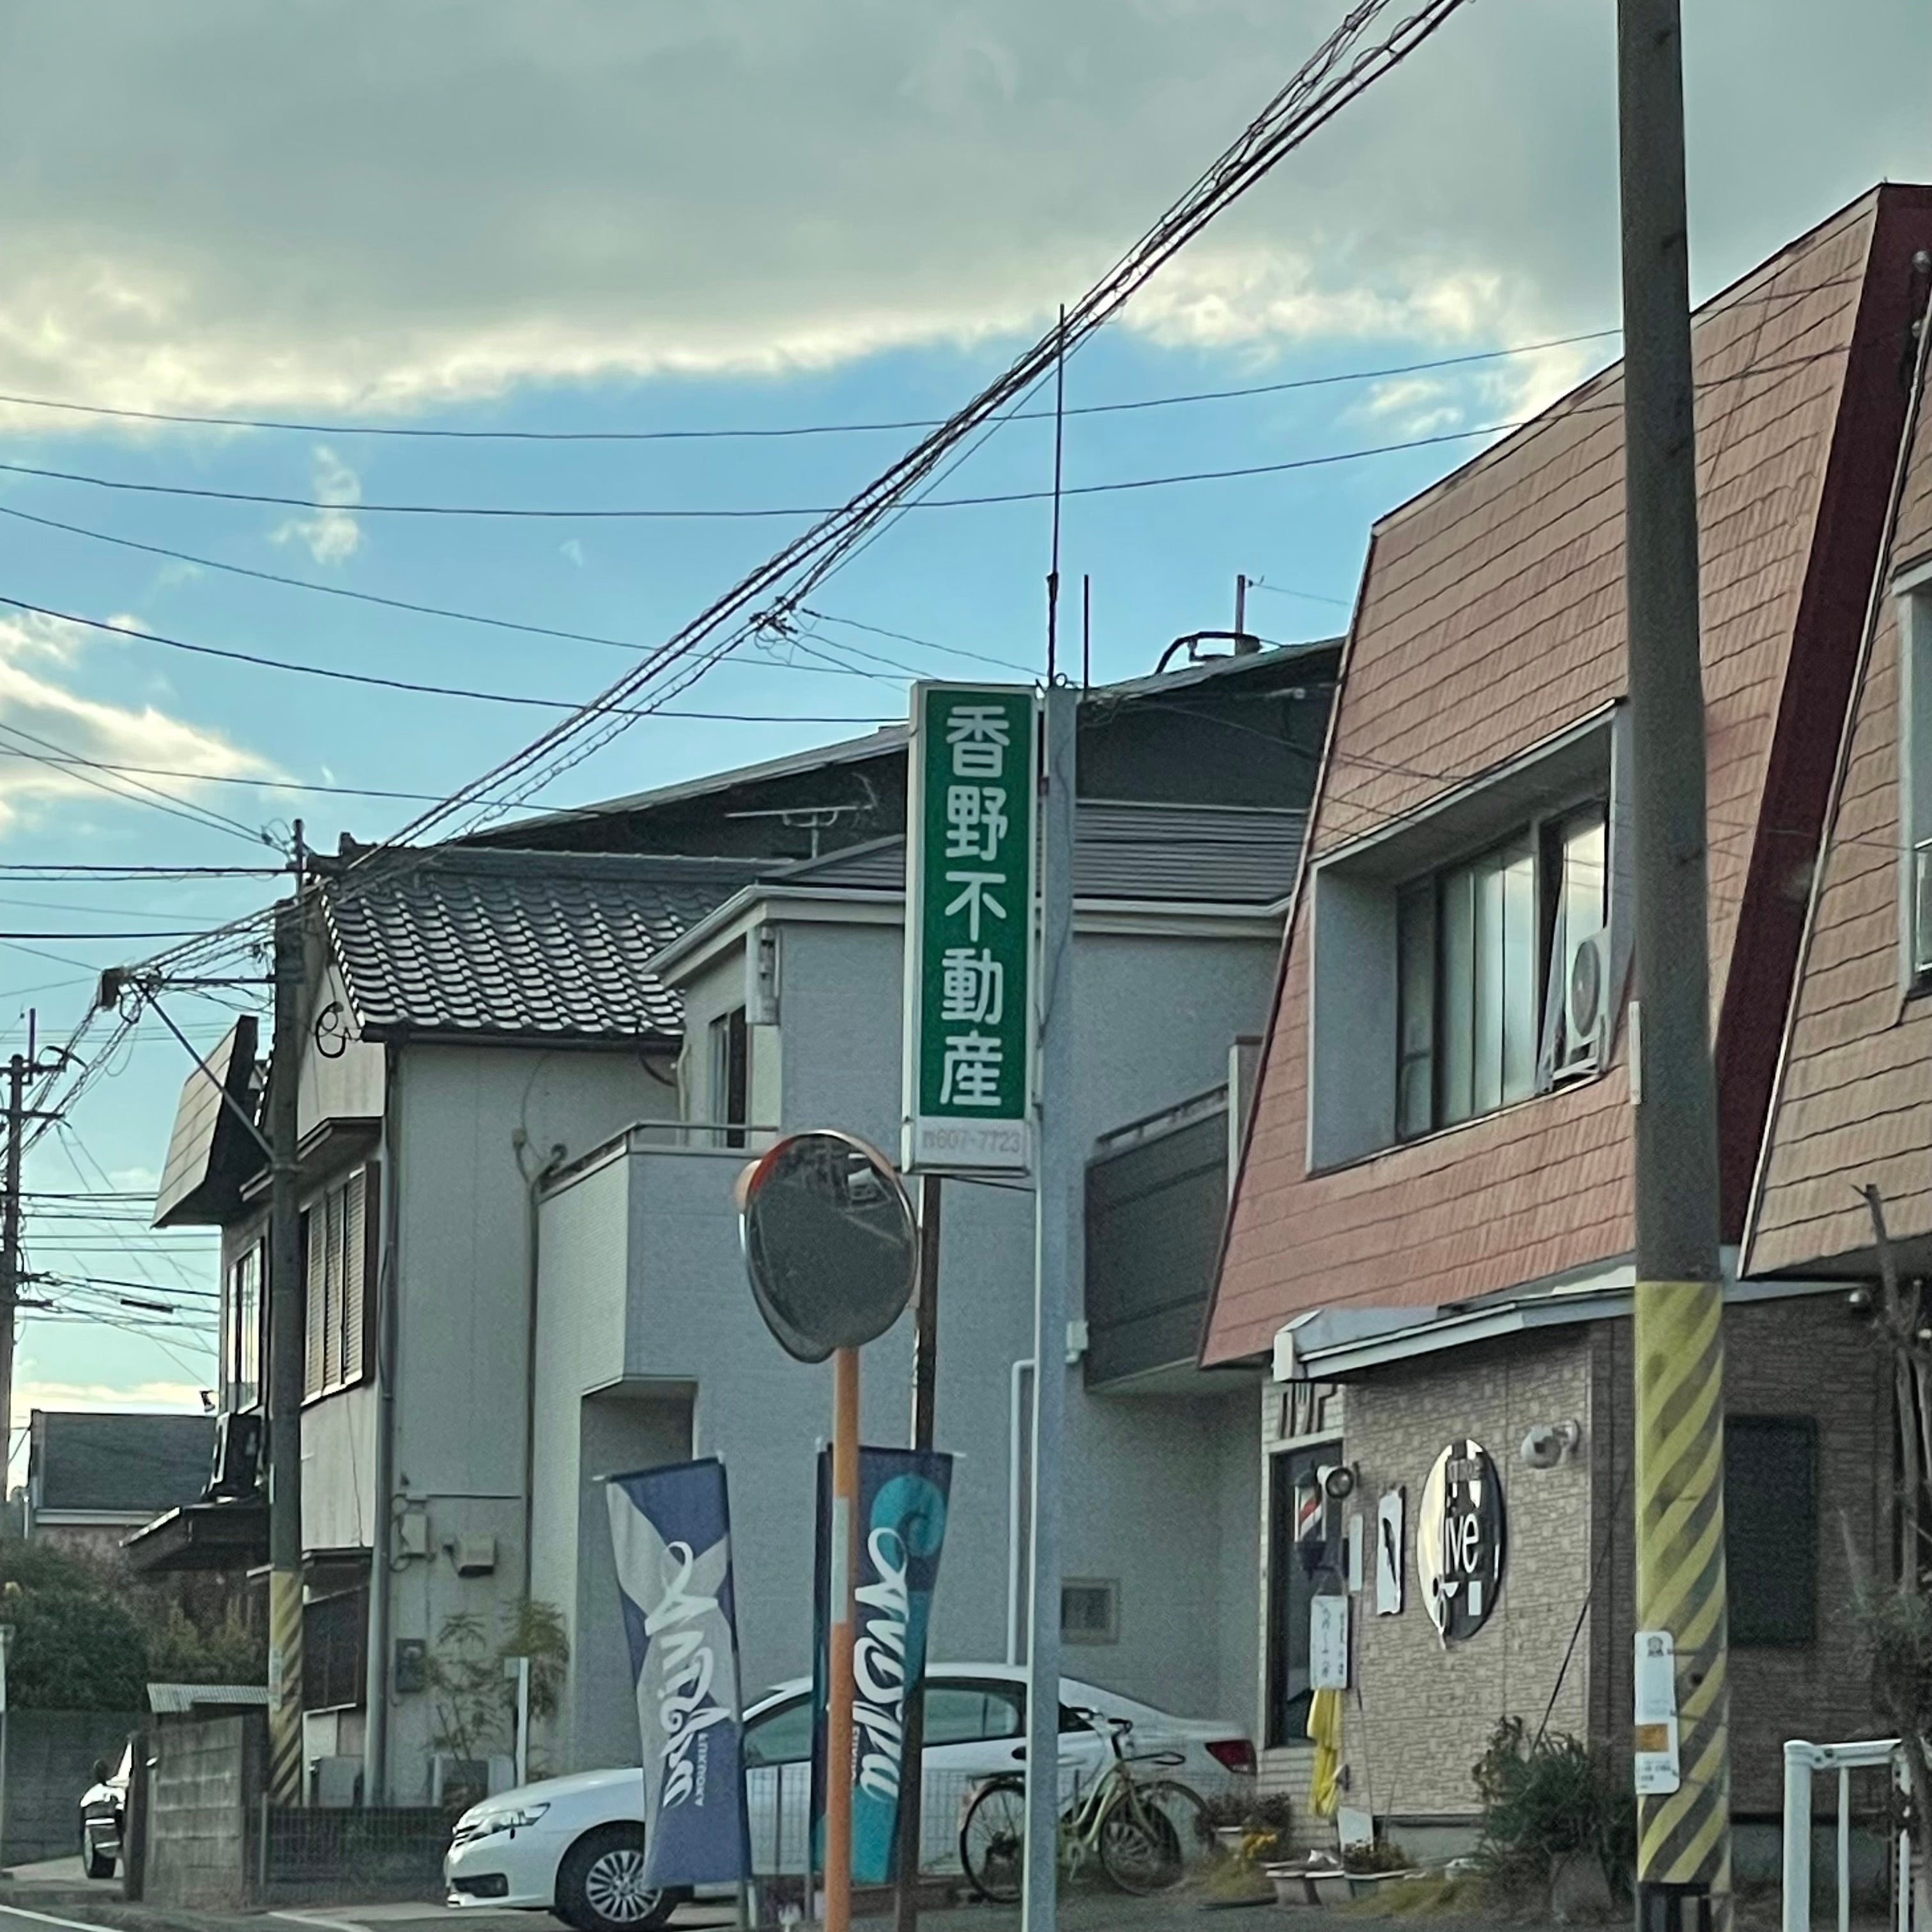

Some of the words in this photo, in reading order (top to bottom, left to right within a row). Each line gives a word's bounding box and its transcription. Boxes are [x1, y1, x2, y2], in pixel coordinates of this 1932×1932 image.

[940, 705, 1009, 1106] 香野不動産
